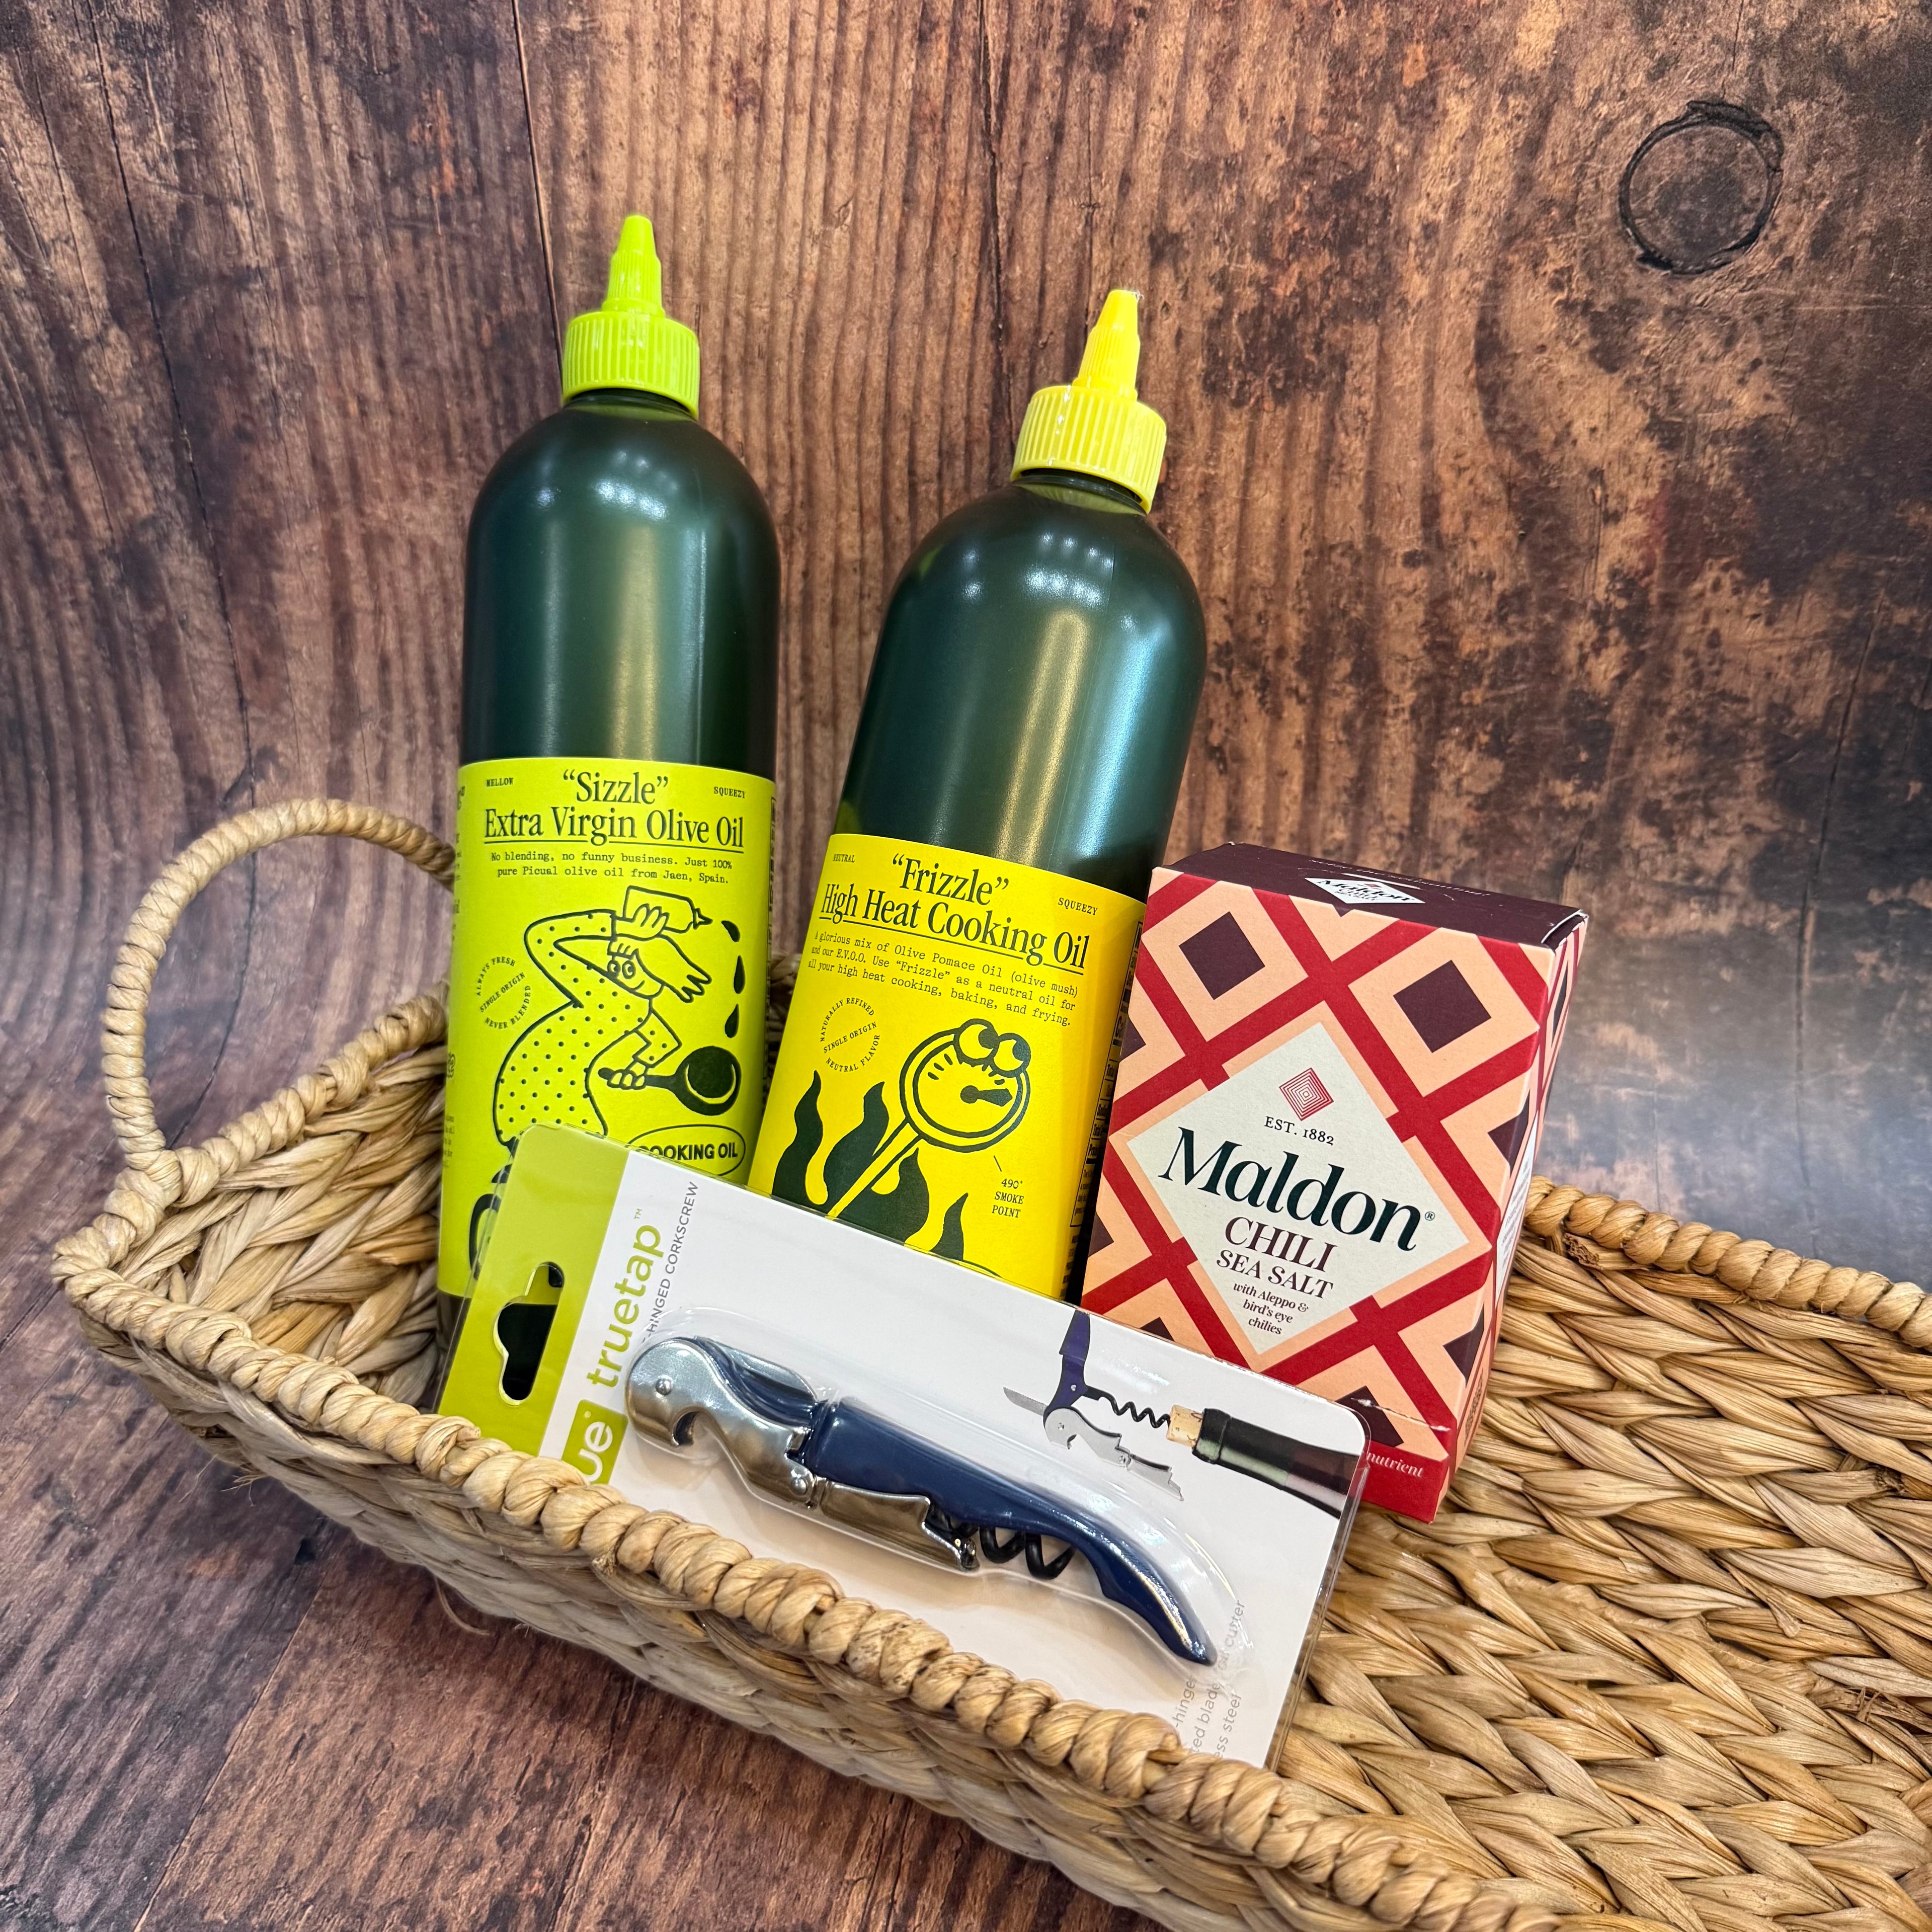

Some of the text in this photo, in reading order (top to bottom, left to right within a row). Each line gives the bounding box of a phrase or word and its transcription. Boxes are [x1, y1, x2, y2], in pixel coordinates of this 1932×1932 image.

[486, 777, 514, 787] MELLOW
[563, 769, 669, 805] “Sizzle”
[713, 786, 745, 799] SQUEEZY
[484, 808, 544, 838] Extra
[551, 806, 637, 846] Virgin
[646, 808, 709, 844] Olive
[716, 816, 744, 848] Oil
[491, 852, 501, 861] No
[505, 851, 554, 862] blending,
[581, 851, 615, 863] funny
[620, 852, 678, 865] business.
[684, 856, 708, 867] Just
[712, 859, 733, 869] 100%
[497, 866, 729, 884] pure Picual olive oil from Jaen, Spain.
[833, 854, 855, 863] NEUTRAL
[892, 853, 1009, 906] “Frizzle”
[1058, 897, 1098, 916] SQUEEZY
[819, 883, 858, 924] High
[861, 888, 922, 929] Heat
[928, 902, 1048, 968] Cooking
[1054, 931, 1090, 969] Oil
[476, 956, 516, 996] ALWAYS FRESH
[811, 945, 1076, 1011] and our E.V.O.O. Use “Frizzle” as a neutral oil for
[819, 931, 851, 945] glorious
[854, 939, 872, 949] mix
[876, 942, 890, 952] of
[895, 944, 926, 960] Olive
[931, 952, 975, 971] Pomace
[982, 964, 1002, 978] Oil
[1011, 971, 1046, 988] (olive
[1051, 983, 1078, 999] mush)
[480, 972, 525, 1012] SINGLE ORIGIN
[485, 986, 531, 1029] NEVER BLENDED
[808, 959, 1070, 1027] all your high heat cooking, baking, and frying.
[821, 998, 874, 1042] NATURALLY REFINED
[824, 1021, 876, 1053] SINGLE ORIGIN
[826, 1035, 880, 1072] NEUTRAL FLAVOR
[1263, 1115, 1334, 1146] EST. 1882
[718, 1142, 738, 1158] OIL
[995, 1191, 1024, 1204] SMOKE
[1001, 1178, 1022, 1189] 490°
[665, 1181, 698, 1274] CORKSCREW
[992, 1205, 1021, 1218] POINT
[1225, 1217, 1338, 1273] CHILI
[1216, 1249, 1334, 1303] SEA SALT
[1233, 1283, 1309, 1313] with Aleppo &
[1248, 1317, 1282, 1335] chilies
[1274, 1312, 1293, 1323] eye
[1367, 1452, 1424, 1478] nutrient
[1223, 1693, 1242, 1732] steel
